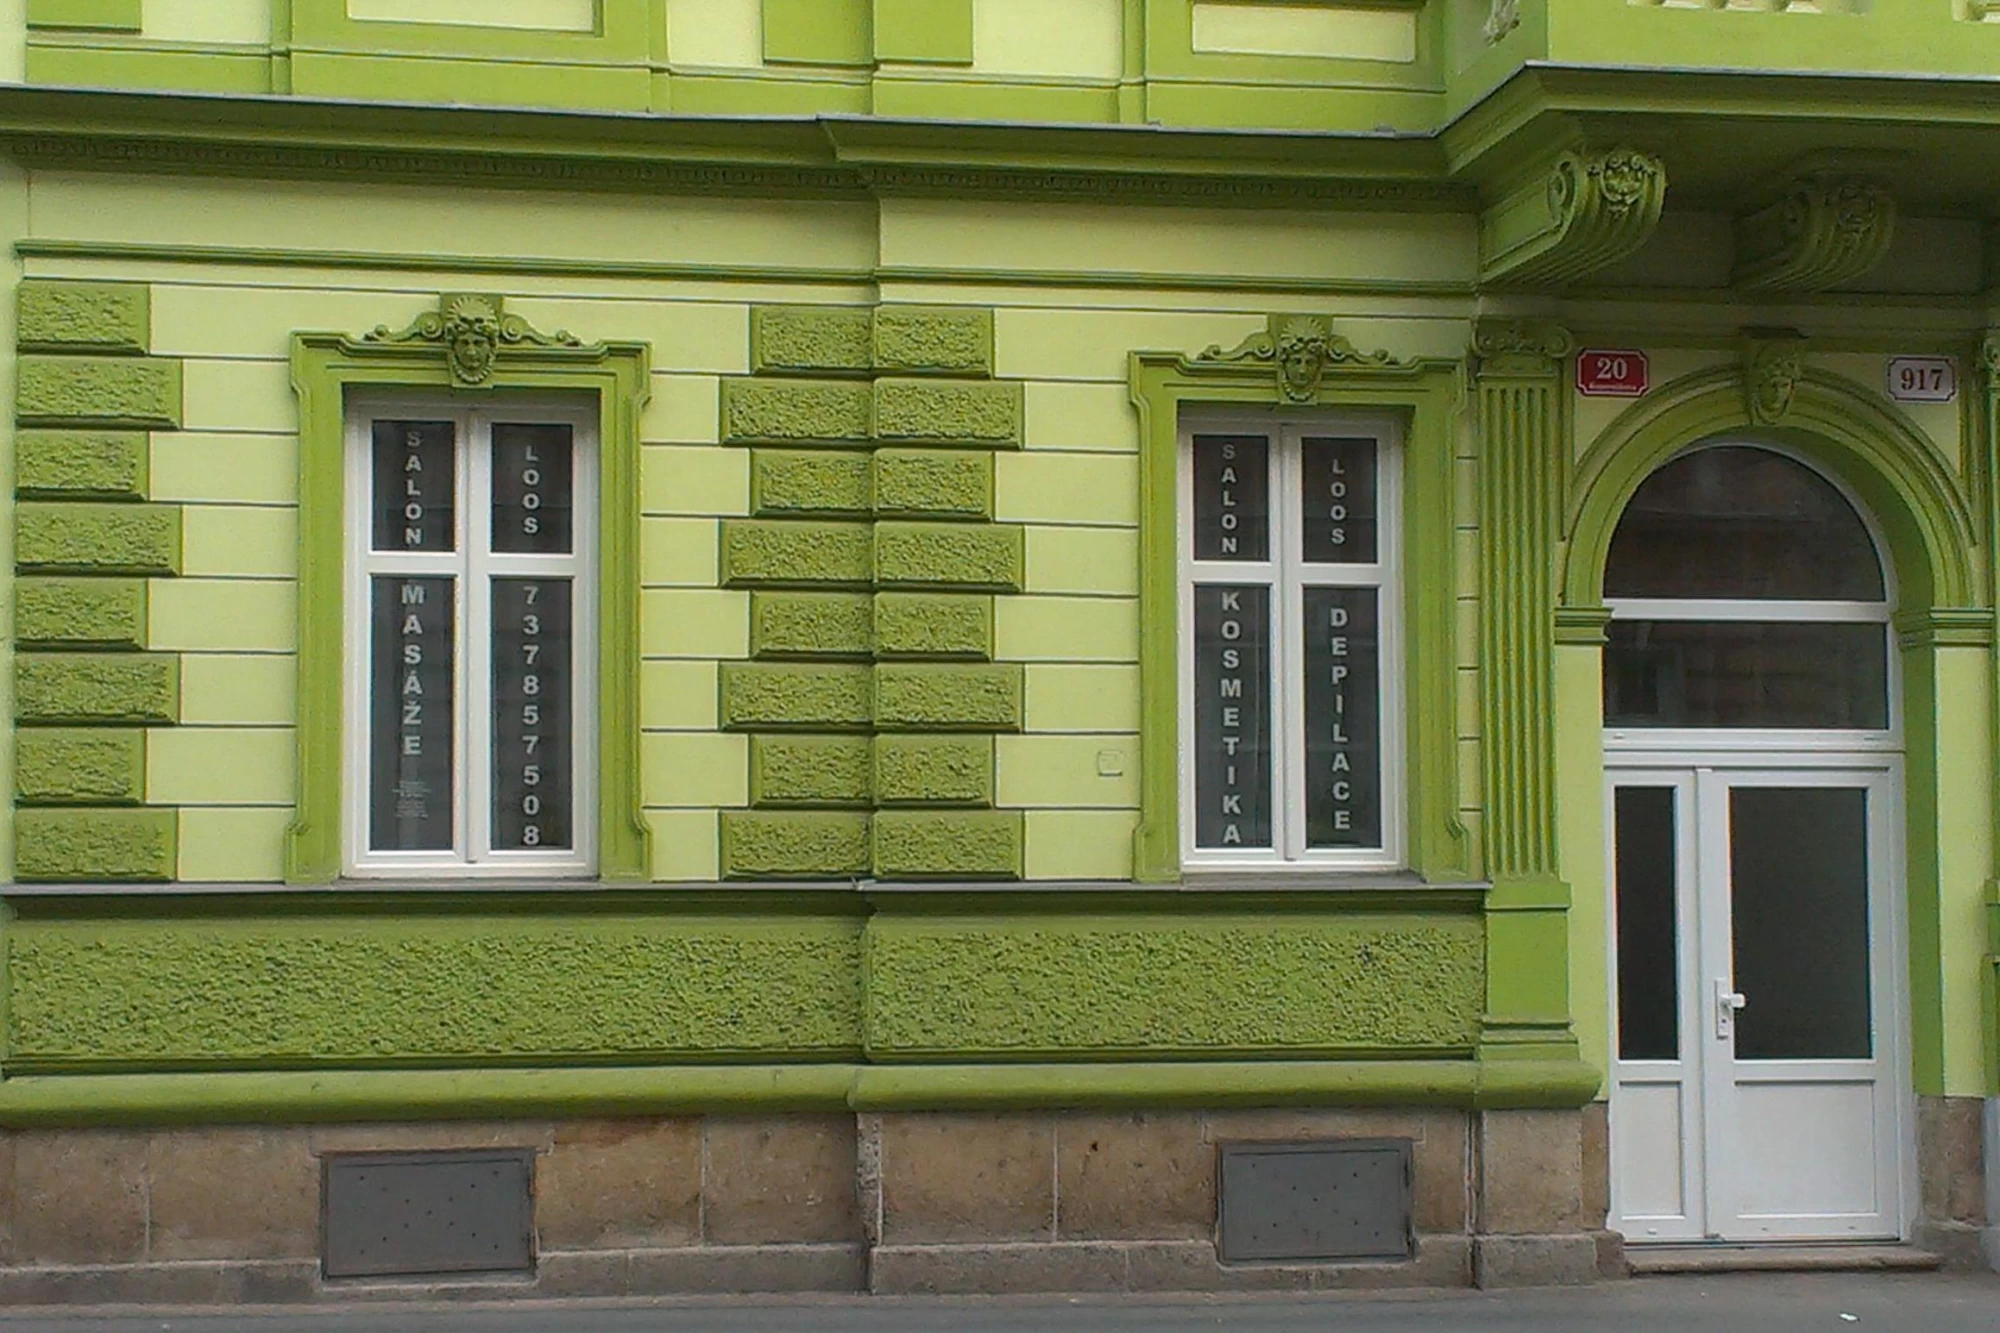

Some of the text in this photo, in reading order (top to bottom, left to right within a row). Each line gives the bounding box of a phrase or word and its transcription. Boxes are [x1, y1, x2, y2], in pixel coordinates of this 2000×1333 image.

[1596, 357, 1627, 380] 20
[1901, 367, 1943, 391] 917
[404, 430, 422, 545] SALON
[523, 445, 540, 534] LOOS
[1222, 443, 1237, 554] SALON
[1332, 459, 1345, 545] LOOS
[401, 584, 424, 756] MASÁŽE
[522, 586, 540, 846] 737857508
[1221, 591, 1242, 844] KOSMETIKA
[1331, 607, 1351, 830] DEPILACE
